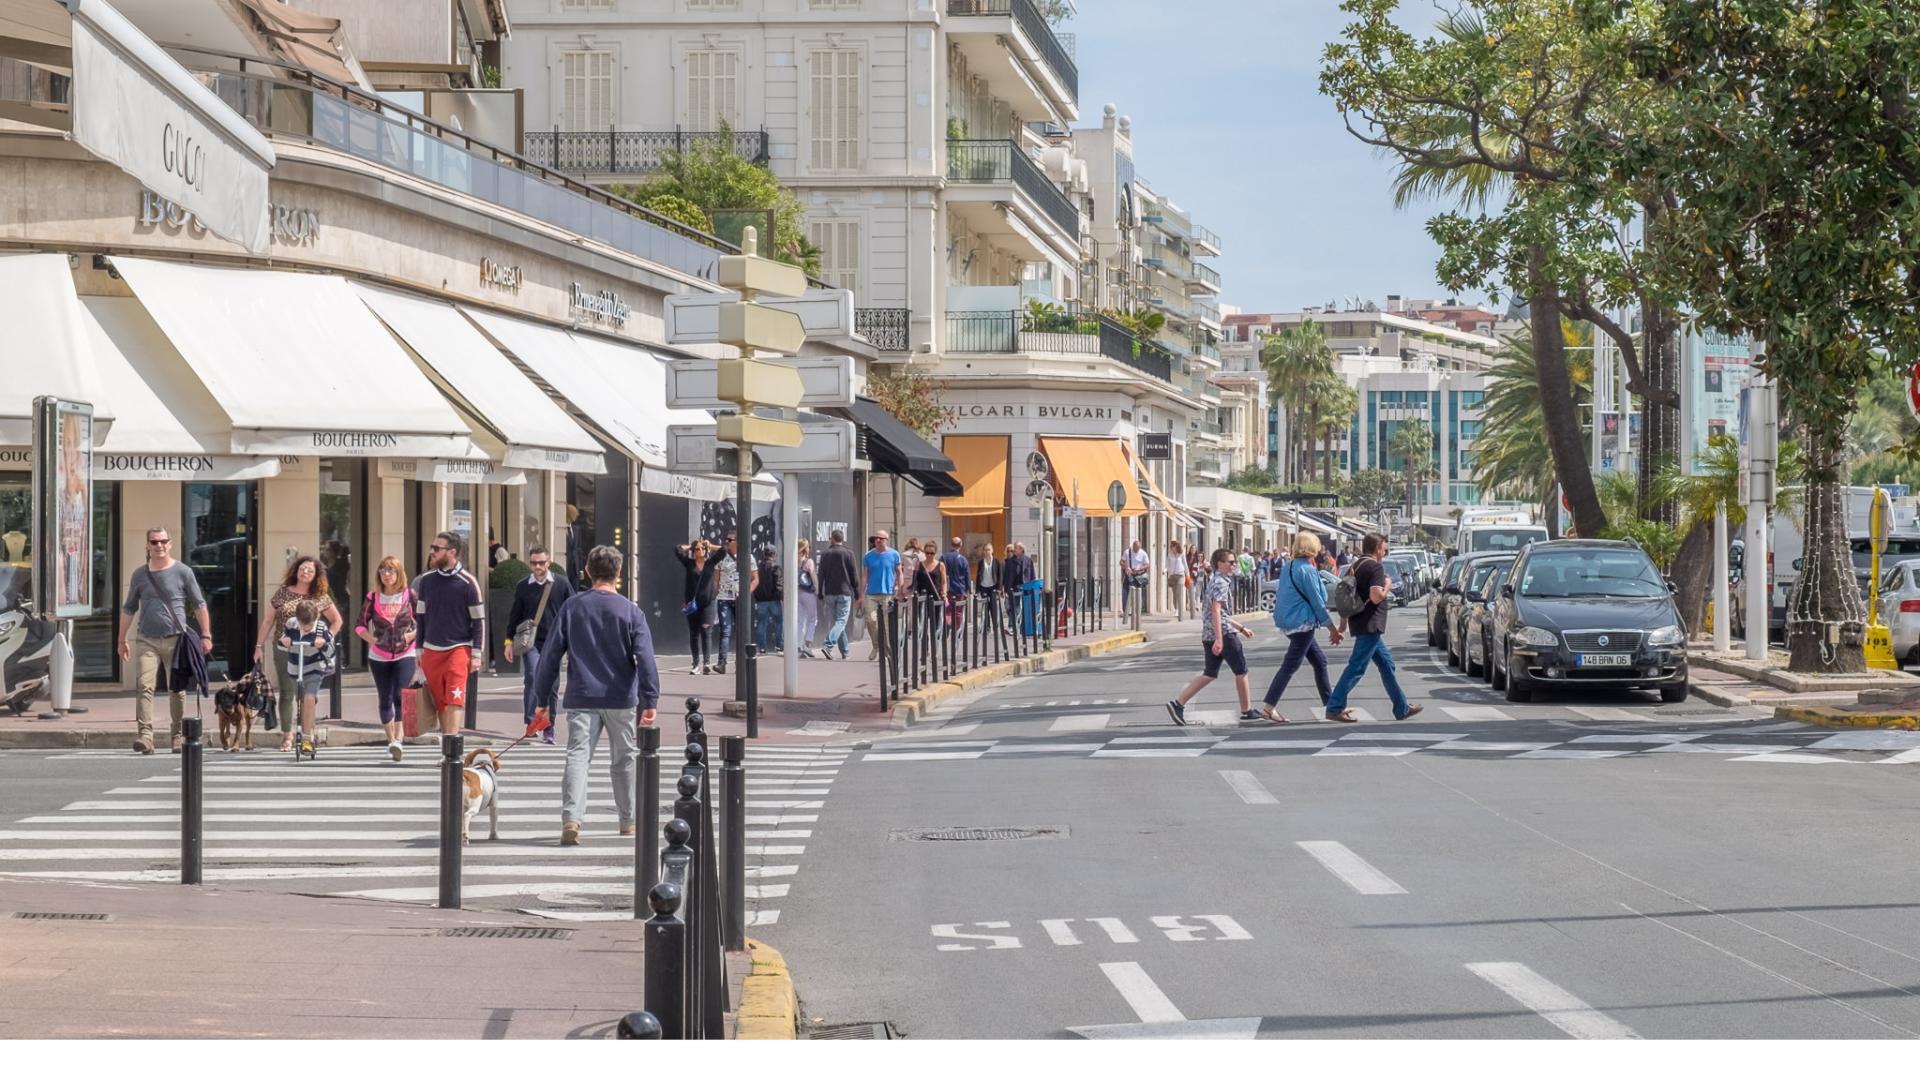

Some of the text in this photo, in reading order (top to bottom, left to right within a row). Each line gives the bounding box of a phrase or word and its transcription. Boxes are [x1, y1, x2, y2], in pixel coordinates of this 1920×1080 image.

[163, 122, 206, 195] GUCCI
[943, 405, 1024, 417] VLGARI
[1038, 406, 1112, 418] BVLGARI
[312, 432, 397, 448] BOUCHERON
[103, 455, 213, 471] BOUCHERON
[446, 459, 495, 474] BOUCHERON
[1583, 655, 1597, 665] 148
[1616, 655, 1627, 665] 06
[930, 914, 1254, 951] BUS
